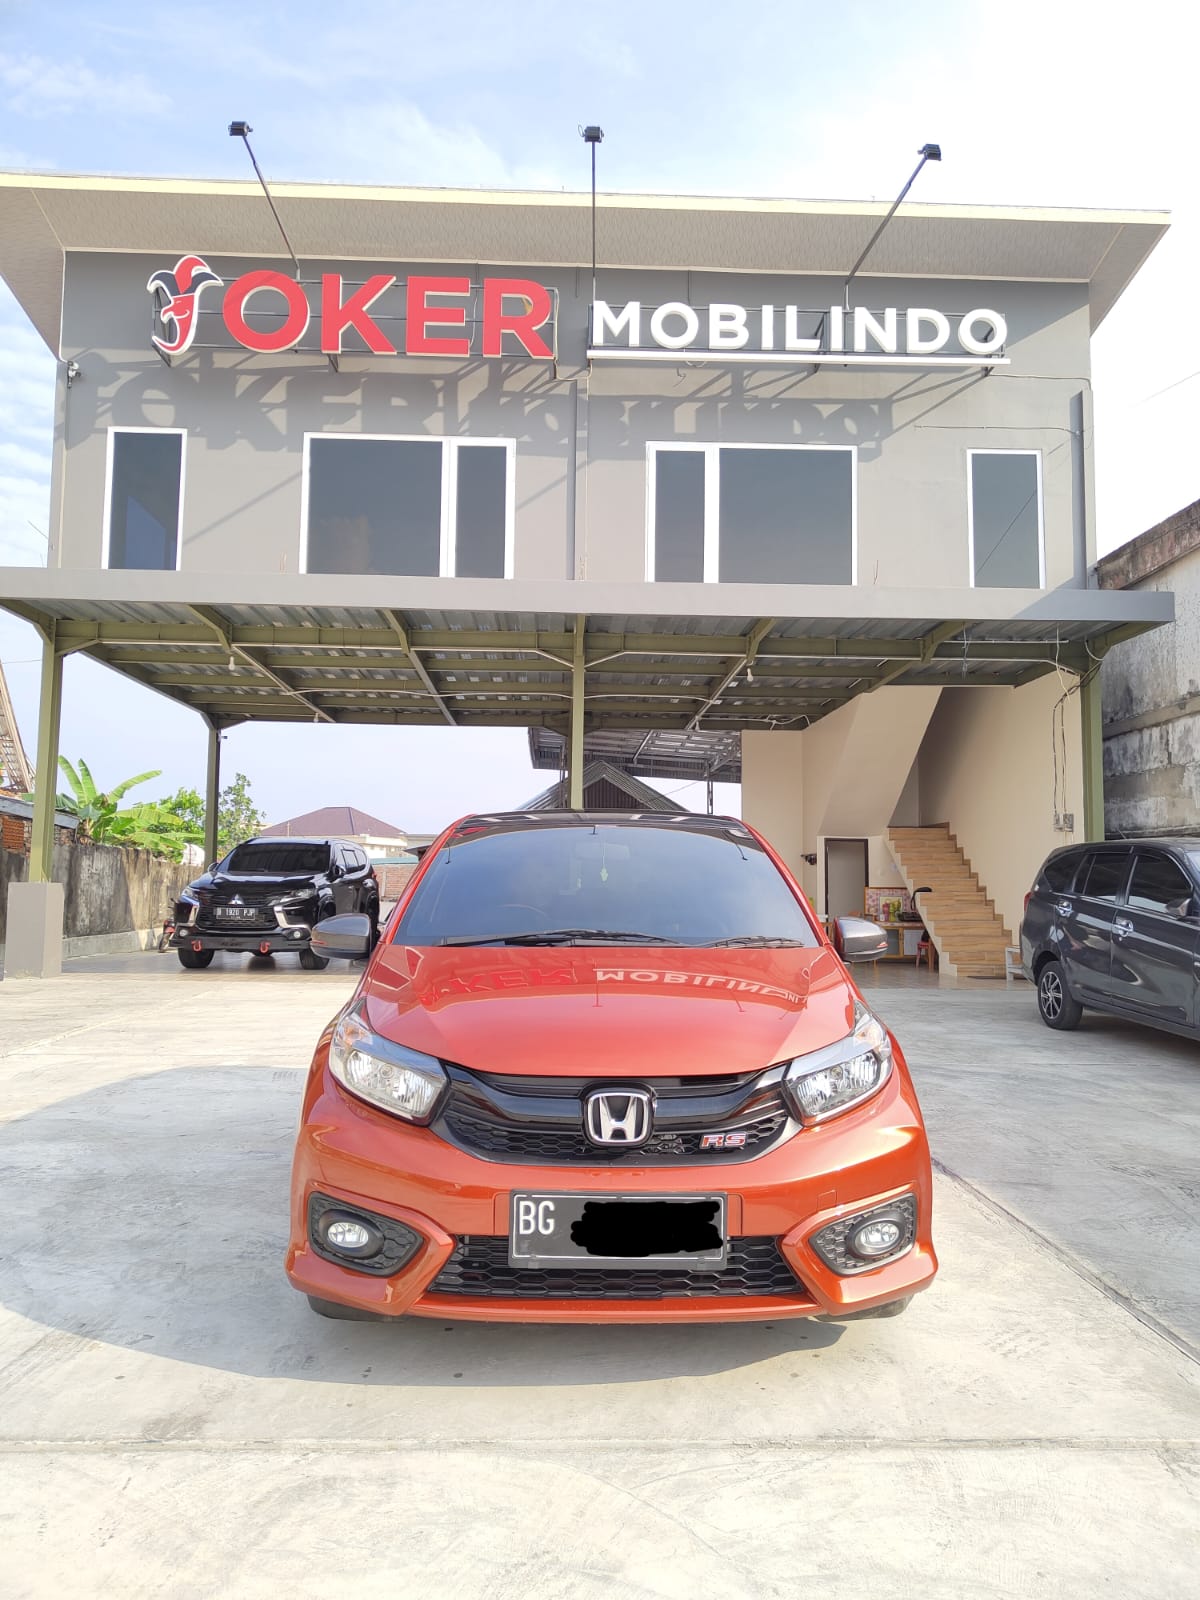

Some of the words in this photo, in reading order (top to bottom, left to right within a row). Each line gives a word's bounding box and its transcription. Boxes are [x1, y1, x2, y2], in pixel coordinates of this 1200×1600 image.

[592, 300, 1008, 355] MOBILINDO
[701, 1132, 746, 1149] RS
[519, 1200, 555, 1235] BG
